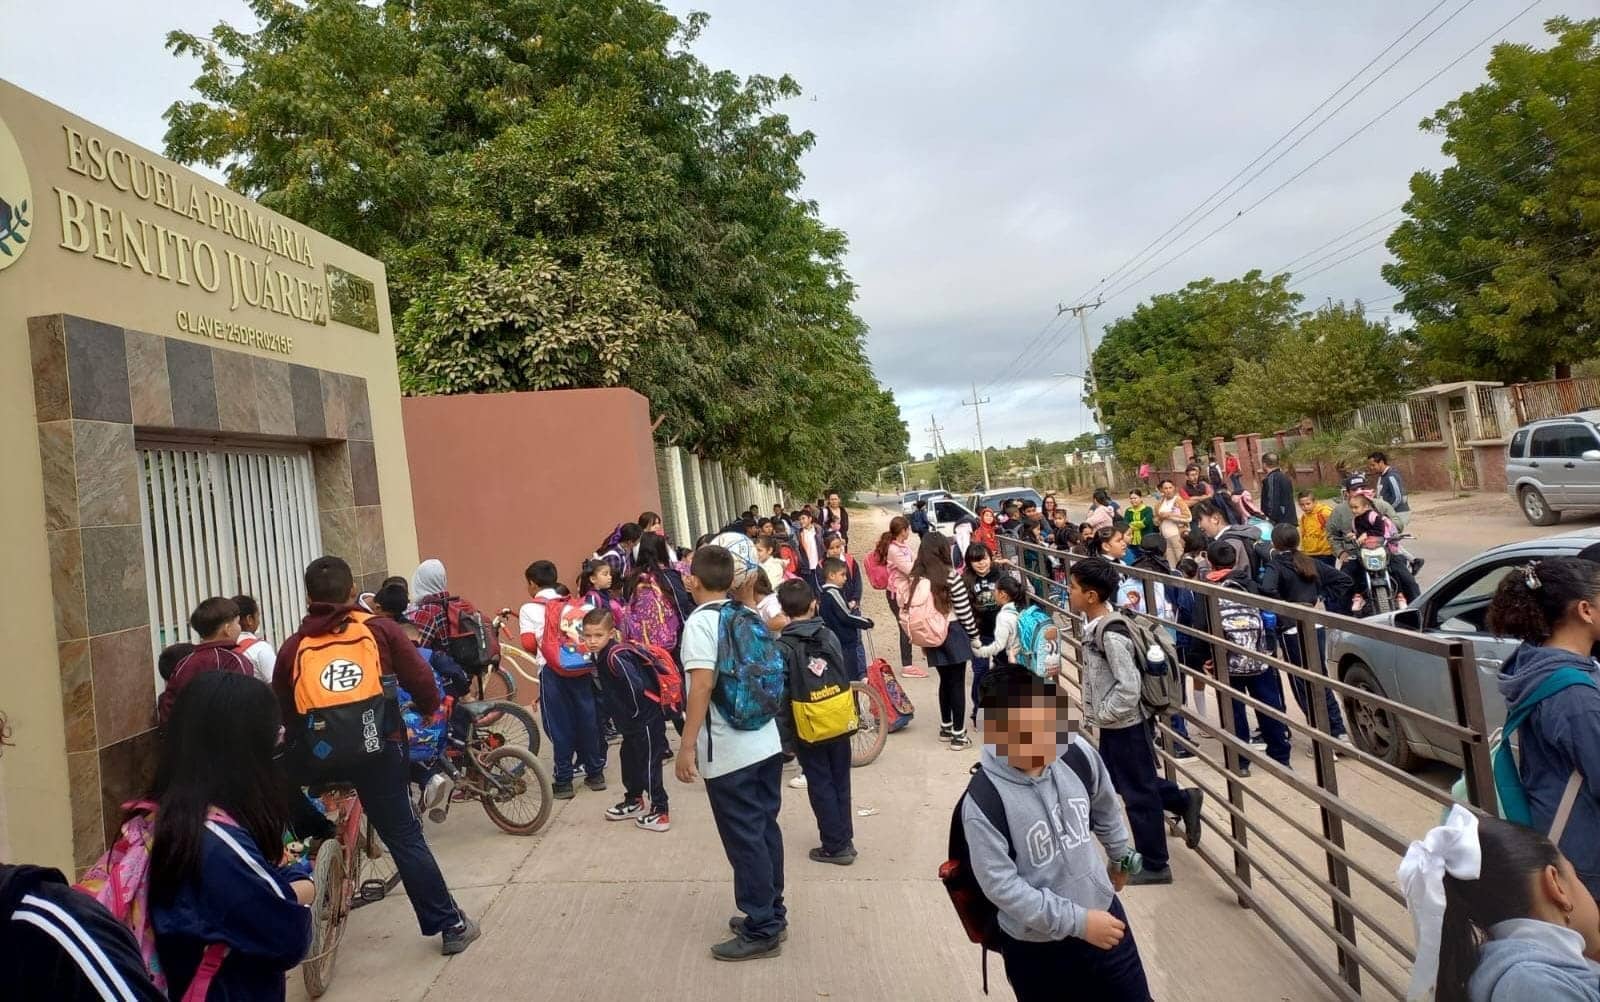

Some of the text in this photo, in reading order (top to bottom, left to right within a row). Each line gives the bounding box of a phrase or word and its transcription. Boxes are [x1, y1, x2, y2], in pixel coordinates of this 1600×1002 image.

[53, 186, 326, 327] BENITO JUÁREZ
[62, 125, 314, 269] ESCUELA PRIMARIA
[324, 663, 362, 691] 悟
